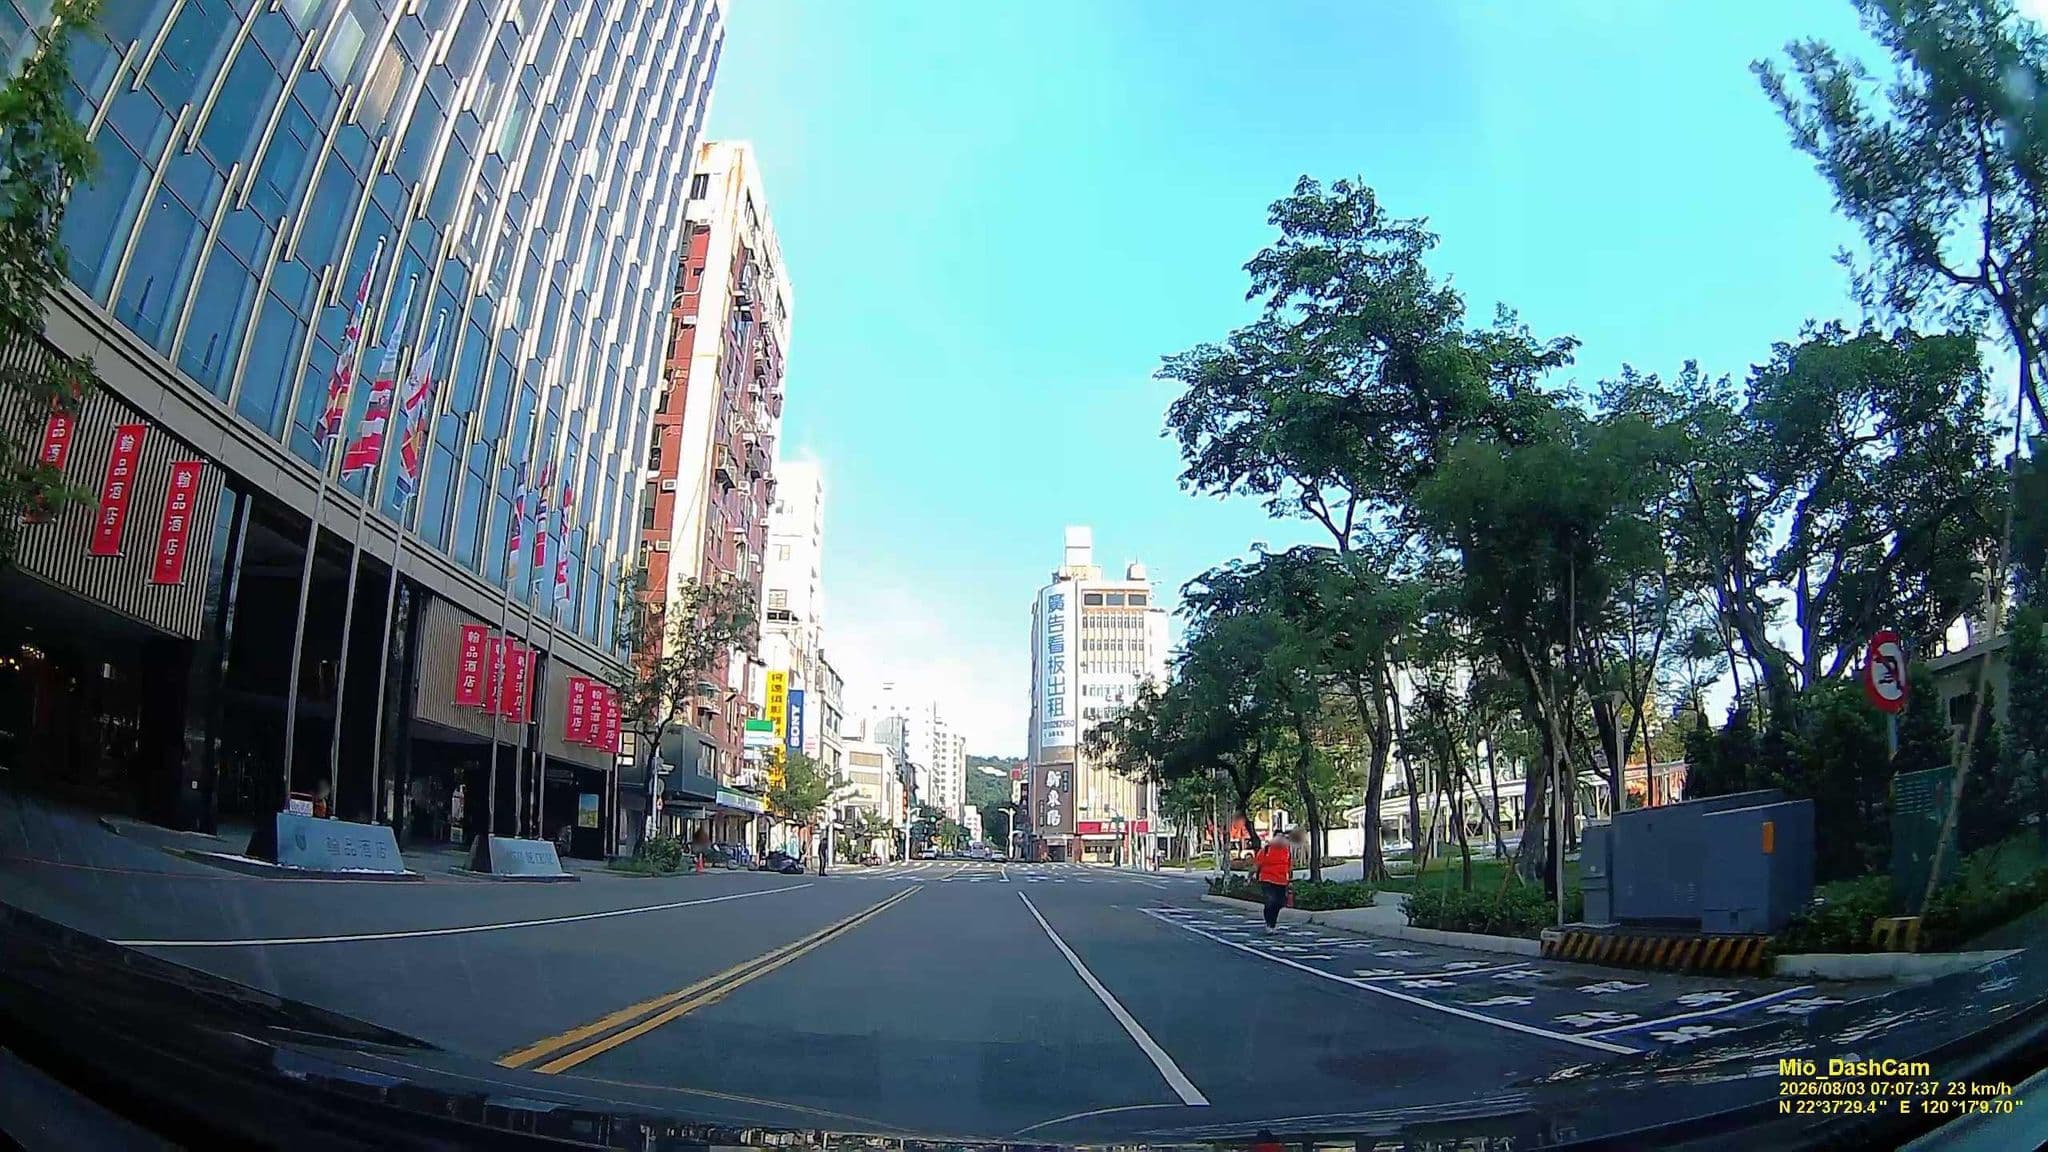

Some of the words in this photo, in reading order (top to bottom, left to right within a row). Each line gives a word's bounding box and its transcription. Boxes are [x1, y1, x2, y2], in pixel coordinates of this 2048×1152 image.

[104, 434, 136, 526] 翰品酒店
[163, 471, 193, 556] 翰品酒店
[463, 631, 480, 688] 翰品酒店
[1047, 594, 1066, 718] 廣告看板出租
[790, 704, 801, 747] SONY
